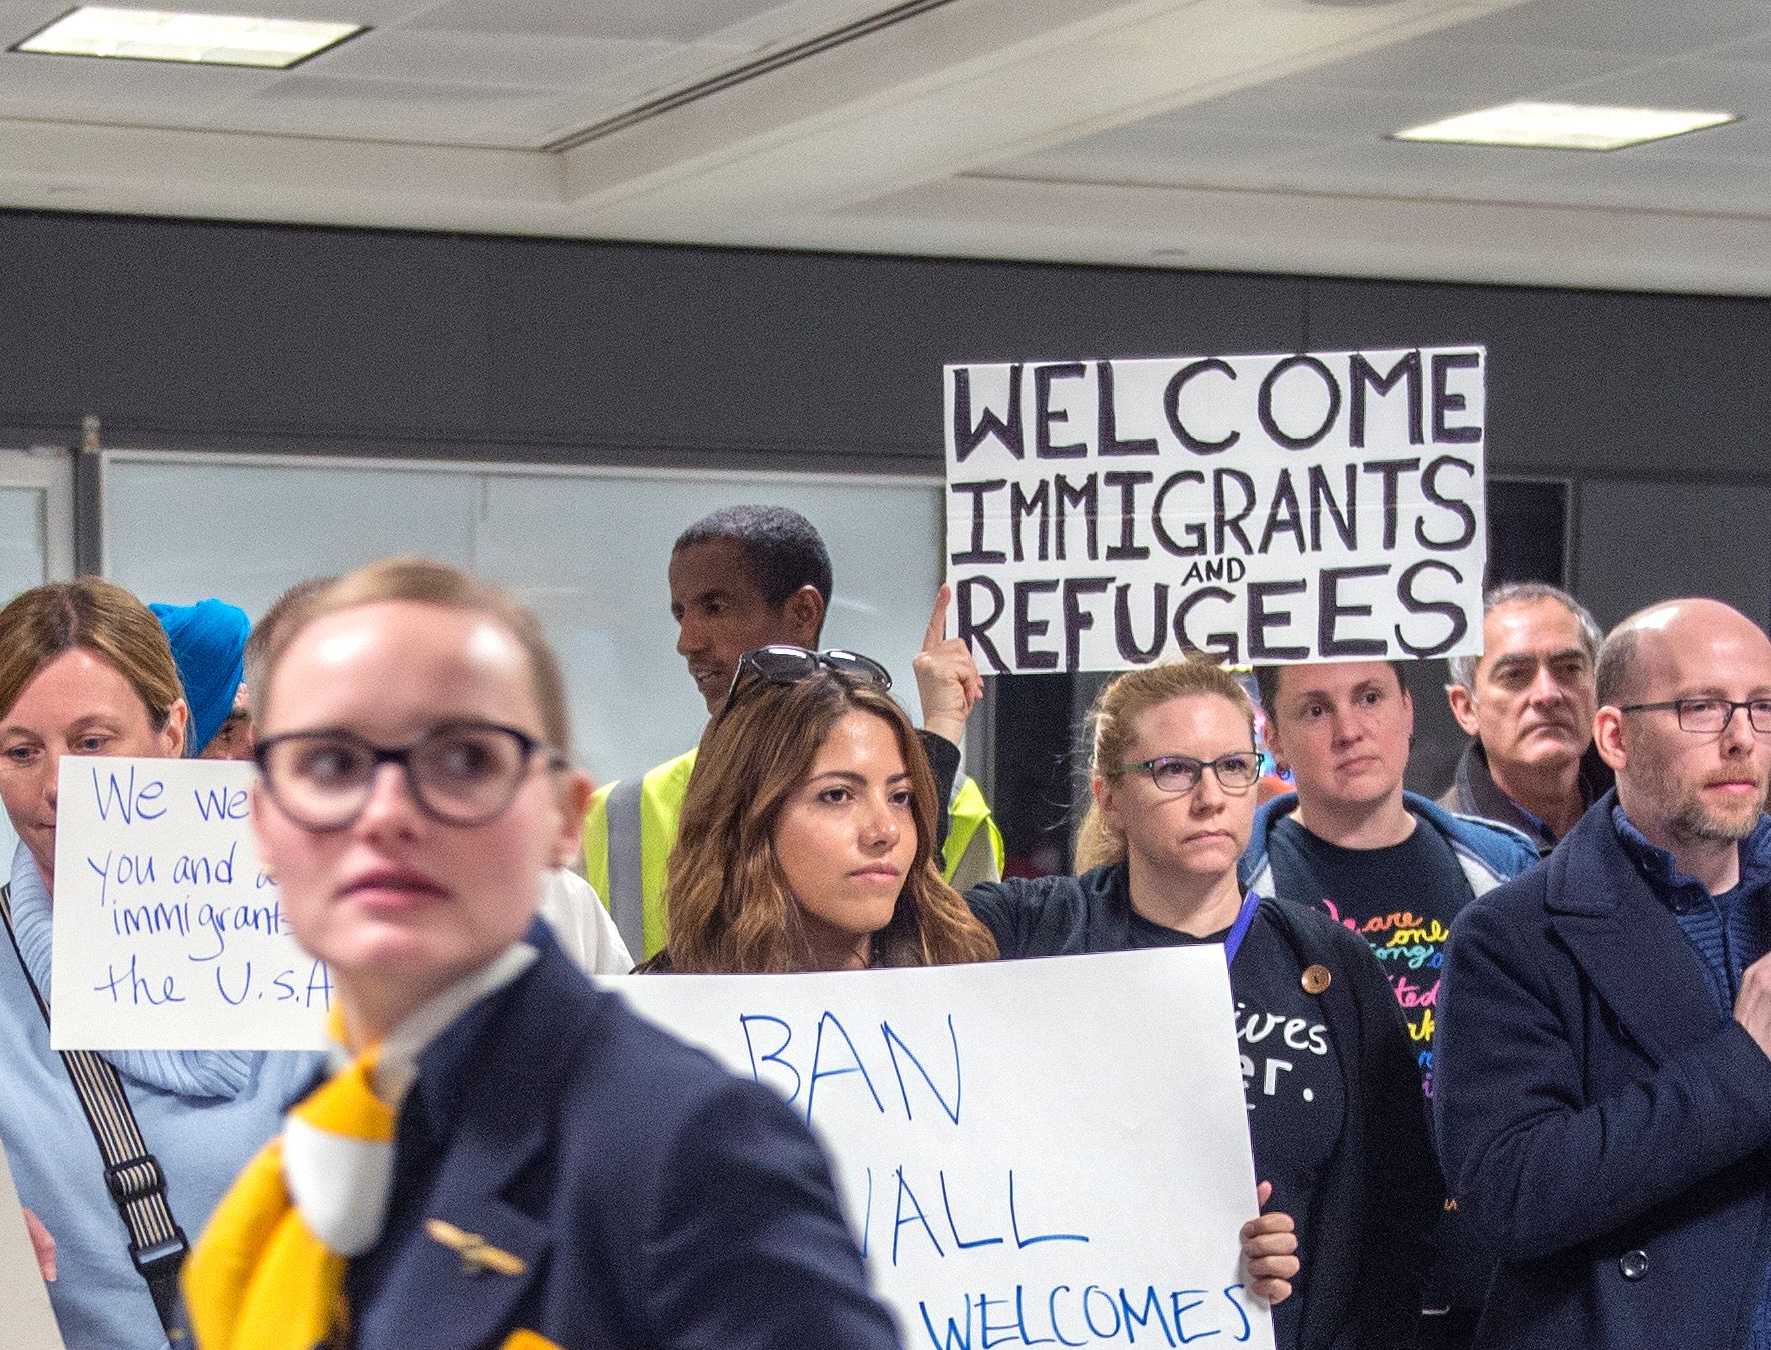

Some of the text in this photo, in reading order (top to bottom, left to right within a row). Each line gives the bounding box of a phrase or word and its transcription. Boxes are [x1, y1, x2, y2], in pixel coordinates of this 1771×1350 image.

[952, 350, 1483, 463] WELCOME
[950, 455, 1477, 564] IMMIGRANTS
[1180, 556, 1246, 587] AND
[956, 560, 1469, 674] REFUGEES
[92, 765, 167, 825] We
[87, 850, 156, 907] you
[173, 841, 237, 885] and
[1361, 911, 1423, 933] are
[94, 954, 186, 1006] the
[1369, 943, 1435, 969] ong
[739, 1011, 962, 1126] BAN
